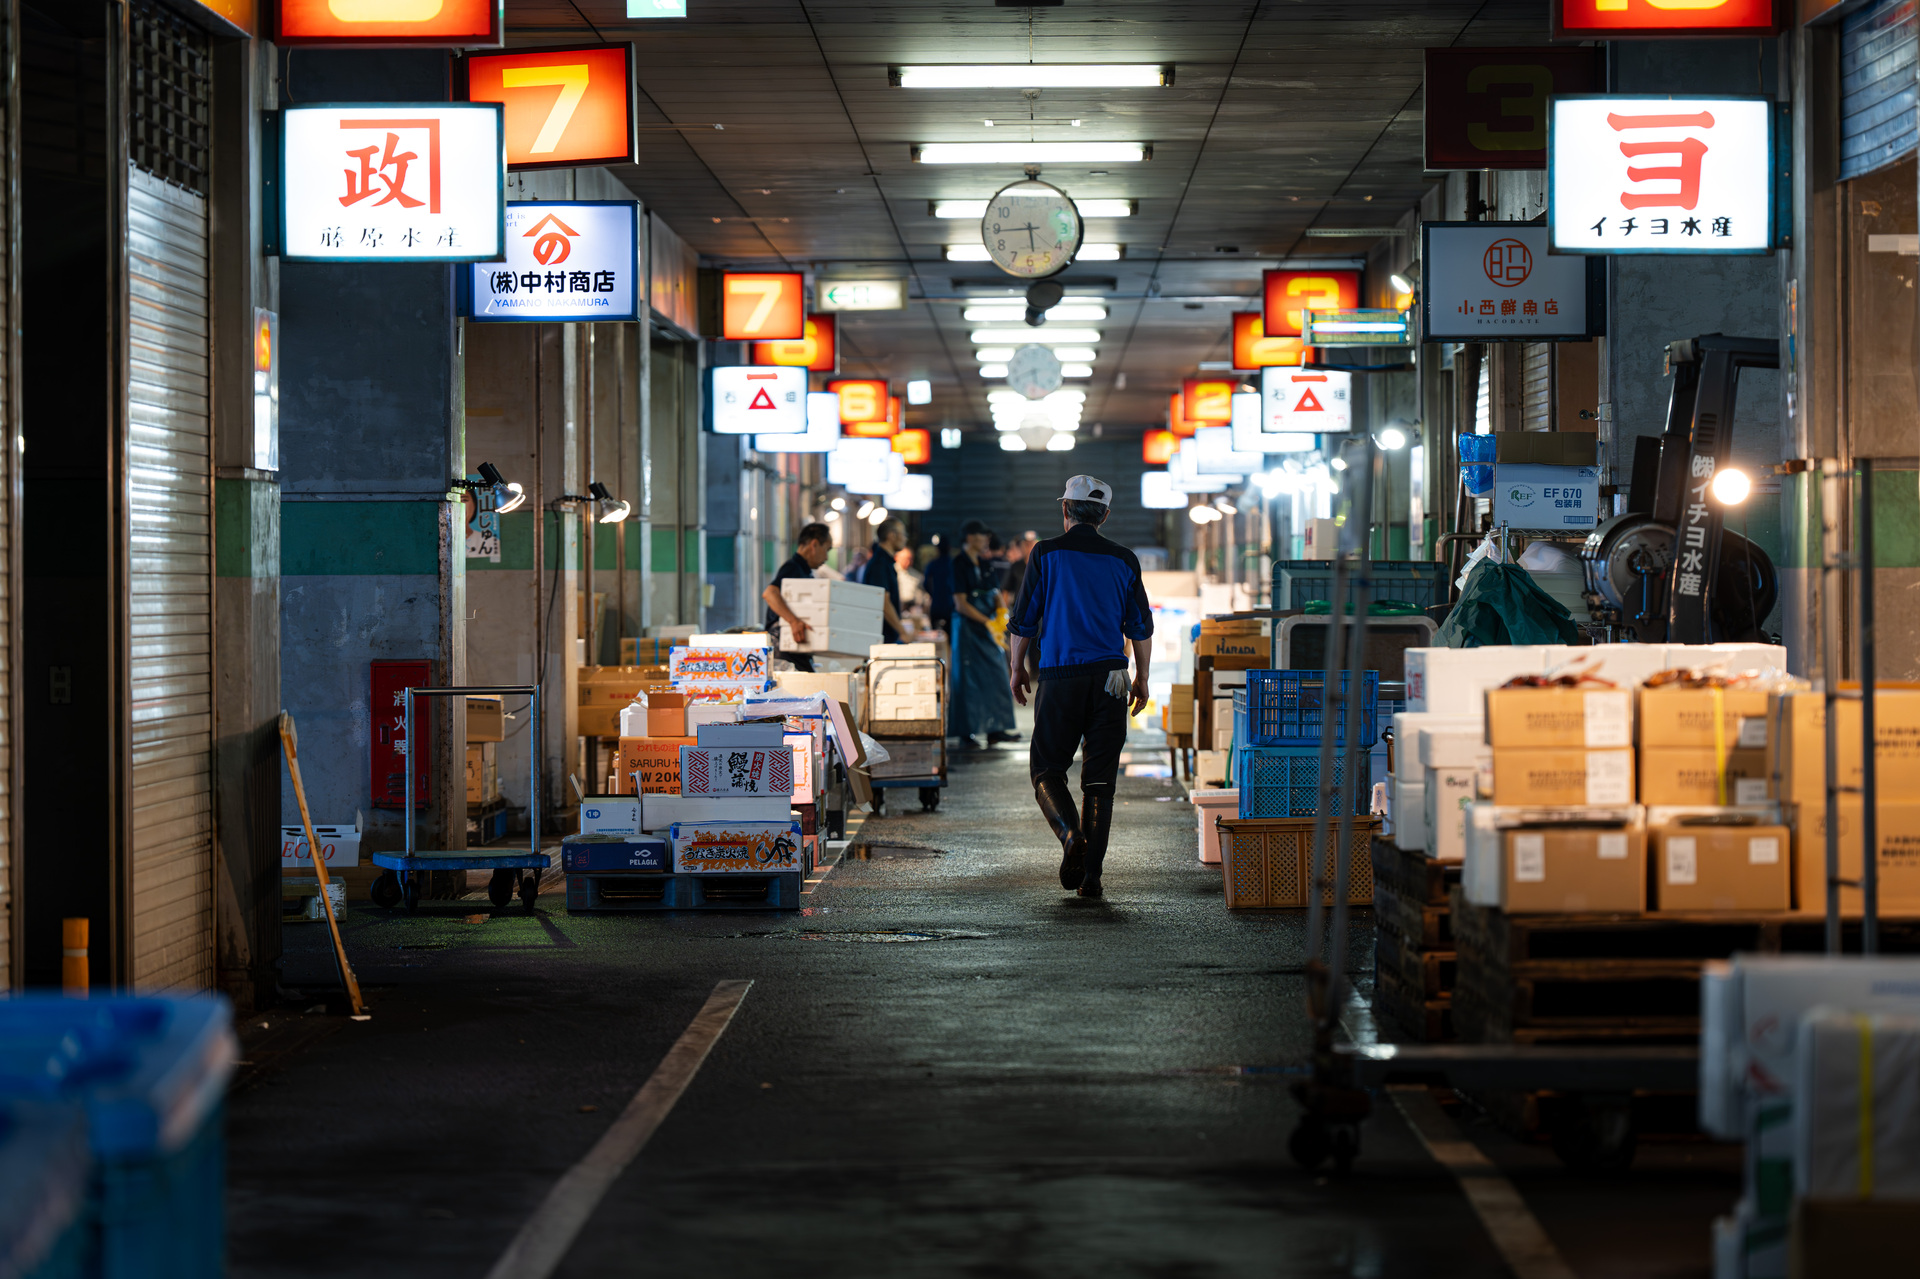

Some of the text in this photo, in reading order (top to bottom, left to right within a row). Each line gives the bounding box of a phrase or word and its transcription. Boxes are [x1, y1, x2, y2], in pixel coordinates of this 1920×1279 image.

[502, 63, 590, 154] 7
[997, 206, 1010, 218] 10
[993, 223, 1001, 235] 9
[1060, 223, 1068, 235] 3
[1590, 216, 1734, 237] イチヨ水産
[320, 226, 463, 248] 藤原水産
[998, 239, 1006, 251] 8
[1026, 256, 1034, 267] 6
[490, 270, 615, 294] (株)中村商店
[495, 298, 610, 308] YAMANO NAKAMURA
[729, 280, 782, 333] 7
[1286, 277, 1340, 330] 3
[1458, 298, 1559, 316] 小西鮮魚店
[1543, 487, 1560, 499] EF
[1562, 487, 1582, 499] 670
[1554, 499, 1582, 509] 包装用
[630, 758, 670, 768] SARURU
